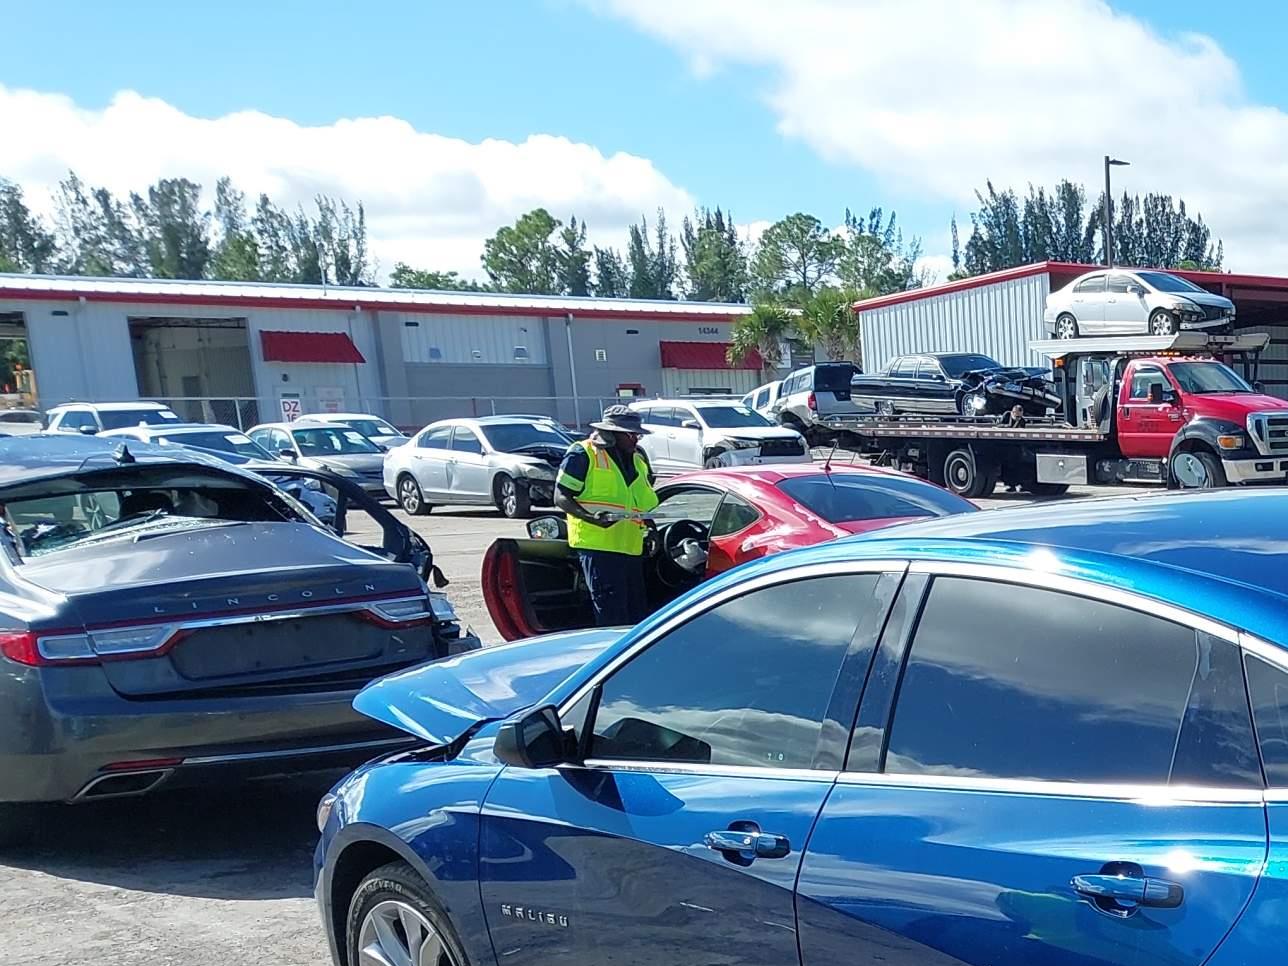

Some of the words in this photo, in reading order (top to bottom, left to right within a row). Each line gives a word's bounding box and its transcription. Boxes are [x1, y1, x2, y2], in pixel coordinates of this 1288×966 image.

[282, 401, 300, 413] DZ
[154, 583, 376, 613] LINCOLN
[501, 904, 568, 927] MALIBU
